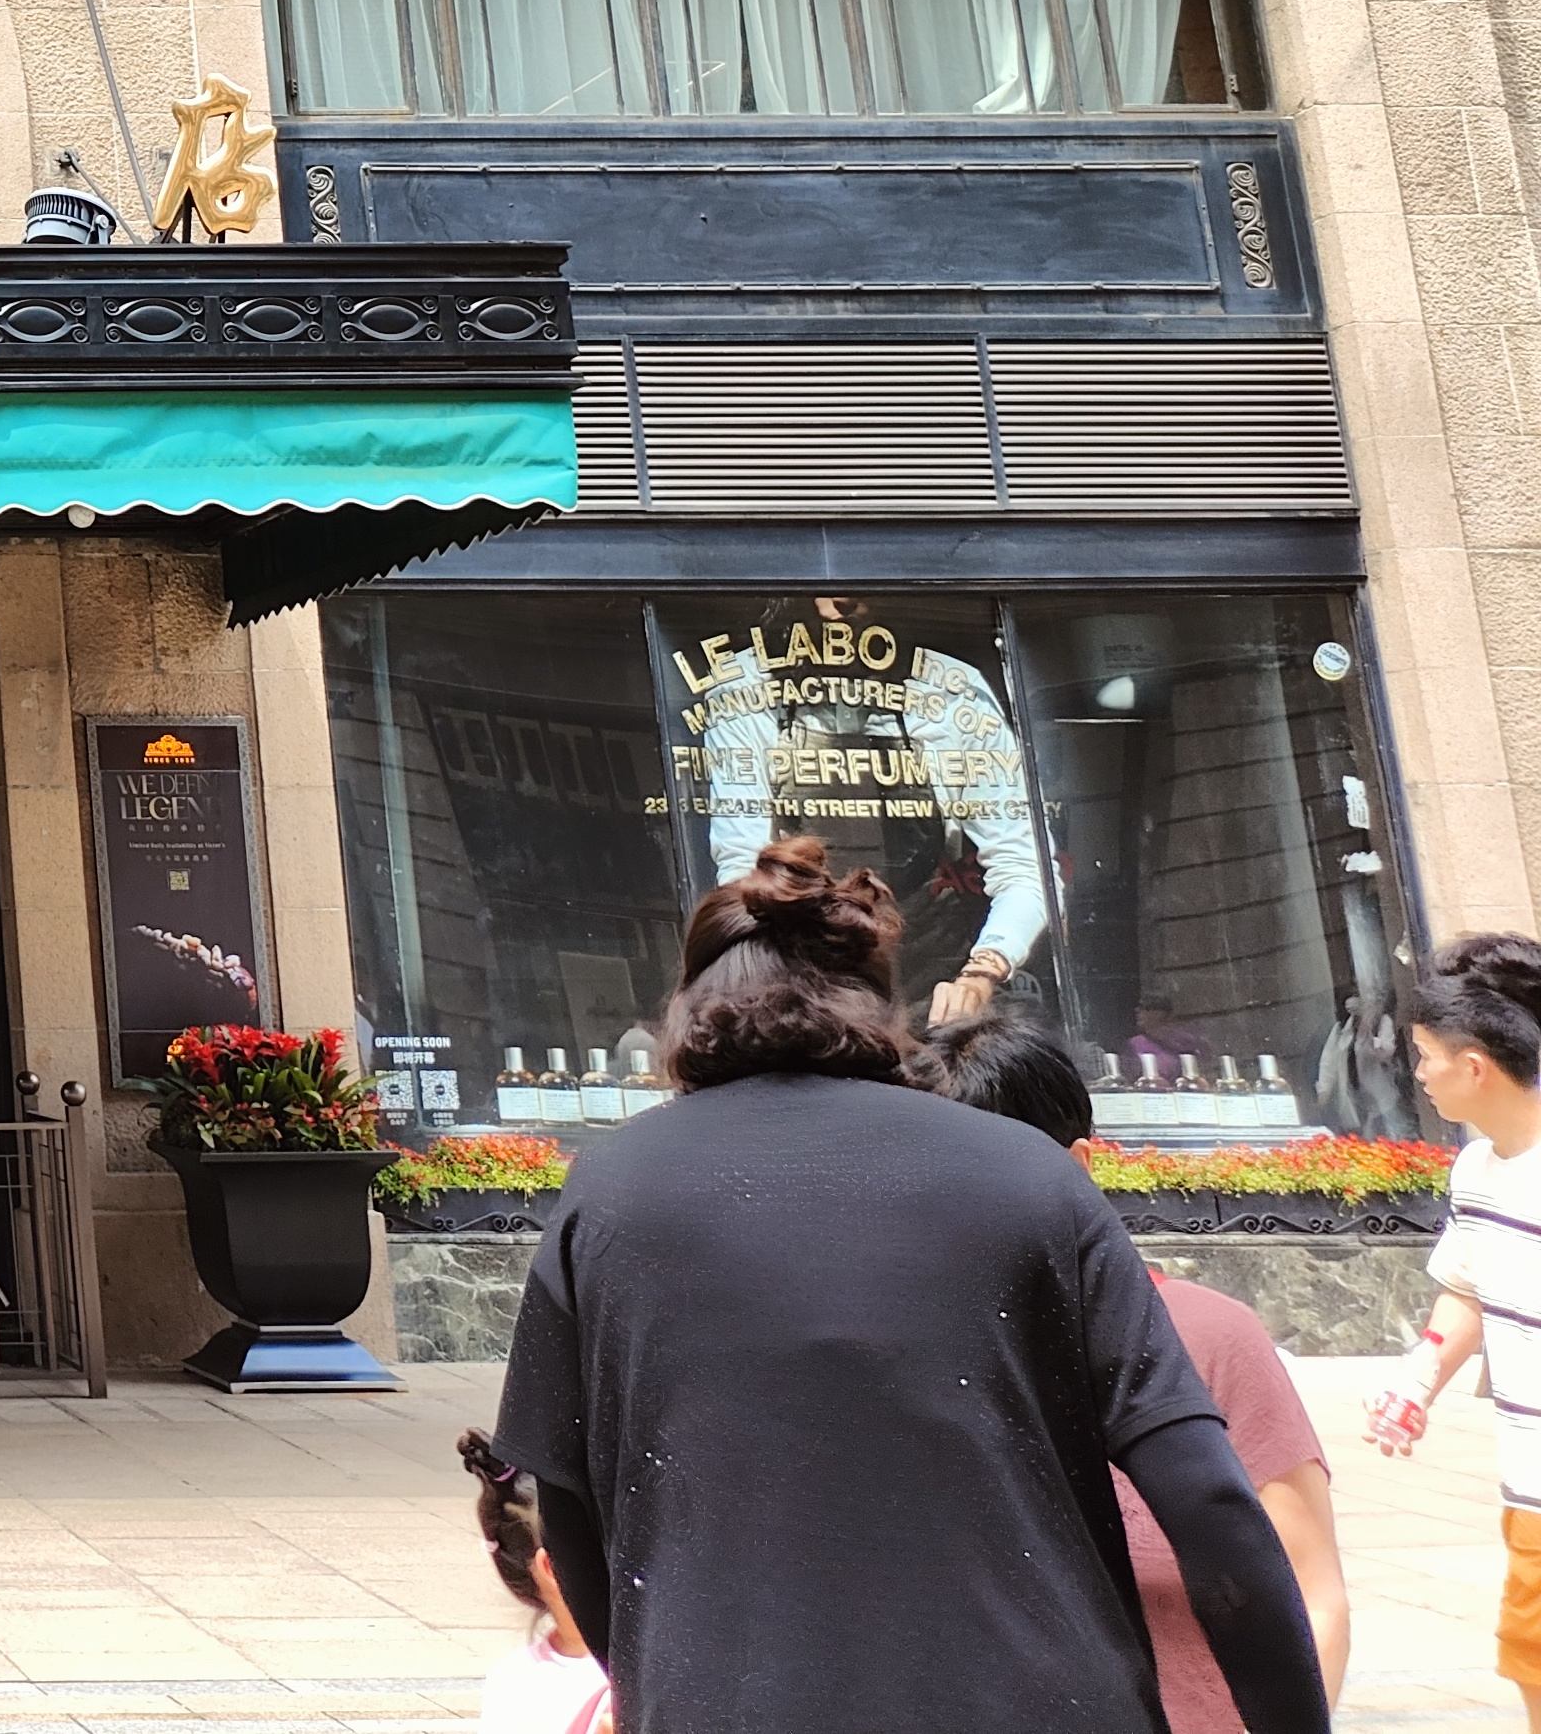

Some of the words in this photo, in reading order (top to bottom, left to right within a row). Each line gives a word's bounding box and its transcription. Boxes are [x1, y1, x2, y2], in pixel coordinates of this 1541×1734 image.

[673, 634, 744, 695] LE
[750, 622, 896, 672] LABO
[912, 646, 978, 701] Inc.
[681, 676, 947, 736] MANUFACTURERS
[953, 704, 1002, 741] OF
[672, 746, 756, 785] FINE
[765, 746, 1023, 788] PERFUMERY
[117, 775, 157, 795] WE
[803, 799, 882, 816] STREET
[885, 800, 934, 817] NEW
[937, 800, 1000, 818] YORK
[375, 1037, 421, 1048] OPENING
[422, 1037, 451, 1048] SOON
